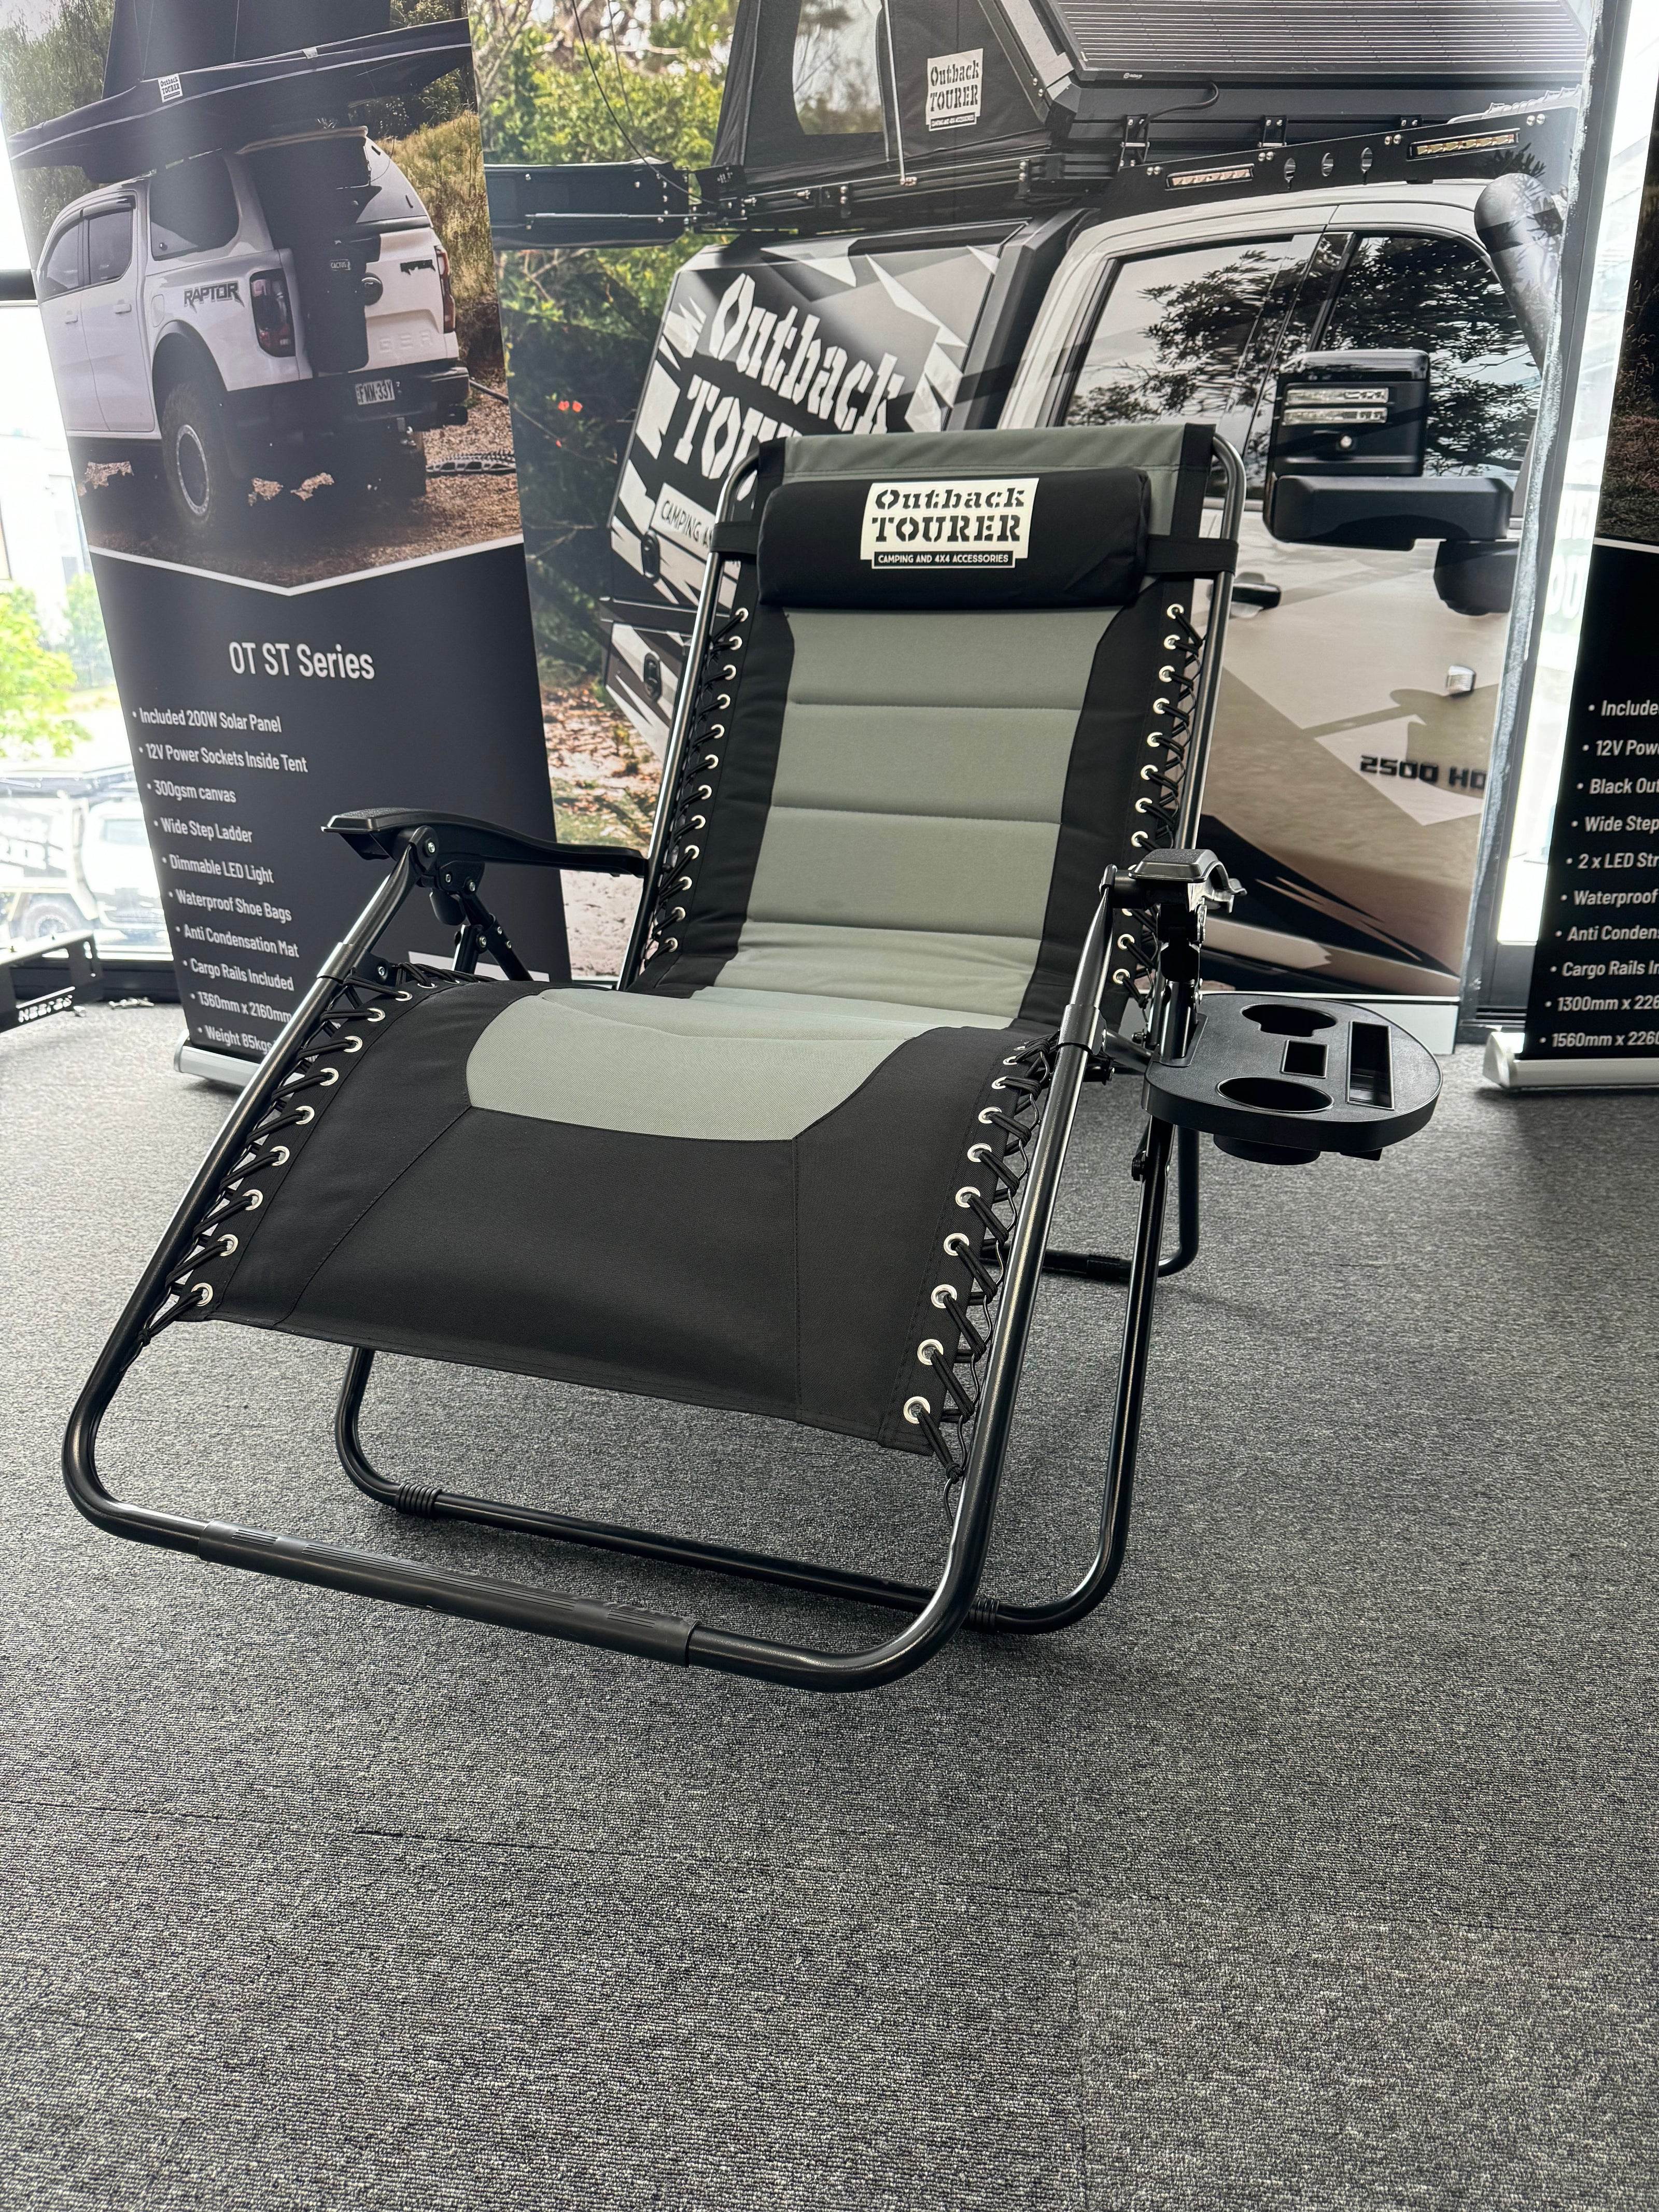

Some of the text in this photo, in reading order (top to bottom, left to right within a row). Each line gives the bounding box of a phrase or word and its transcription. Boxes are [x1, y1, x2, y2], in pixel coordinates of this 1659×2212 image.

[931, 60, 979, 86] Outback
[162, 83, 180, 94] TOURER
[930, 84, 978, 111] TOURER
[184, 280, 245, 314] RAPTOR
[709, 273, 905, 434] Outback
[876, 488, 1025, 510] Outback
[661, 500, 702, 542] CAMPING
[872, 515, 1020, 542] TOURER
[878, 555, 913, 563] CAMPING
[917, 555, 932, 563] AND
[952, 554, 1009, 563] ACCESSORIES
[229, 642, 375, 680] OT ST Series
[1601, 699, 1659, 716] Include
[139, 707, 282, 733] Included 200W Solar Panel
[145, 743, 308, 773] 12V Power Sockets Inside Tent
[1596, 739, 1659, 756] 12V Pow
[1360, 755, 1439, 783] 2500
[153, 780, 236, 802] 300gsm canvas
[1589, 778, 1633, 794] Black
[160, 817, 252, 843] Wide Step Ladder
[1584, 815, 1659, 834] Wide Step
[169, 854, 274, 885] Dimmable LED Light
[1578, 853, 1589, 869] 2
[1591, 856, 1602, 869] x
[1604, 852, 1634, 868] LED
[175, 889, 292, 924] Waterproof Shoe Bags
[1573, 888, 1659, 908] Waterproof
[184, 924, 300, 958] Anti Condensation Mat
[1566, 924, 1659, 941] Anti Conden
[190, 957, 294, 991] Cargo Rails Included
[1562, 962, 1606, 980] Cargo
[1608, 960, 1646, 975] Rails
[197, 991, 240, 1013] 1360mm
[241, 1003, 249, 1015] x
[1557, 996, 1619, 1012] 1300mm
[1621, 998, 1632, 1010] x
[205, 1024, 241, 1047] Weight
[1552, 1033, 1612, 1048] 1560mm
[1614, 1035, 1625, 1046] x
